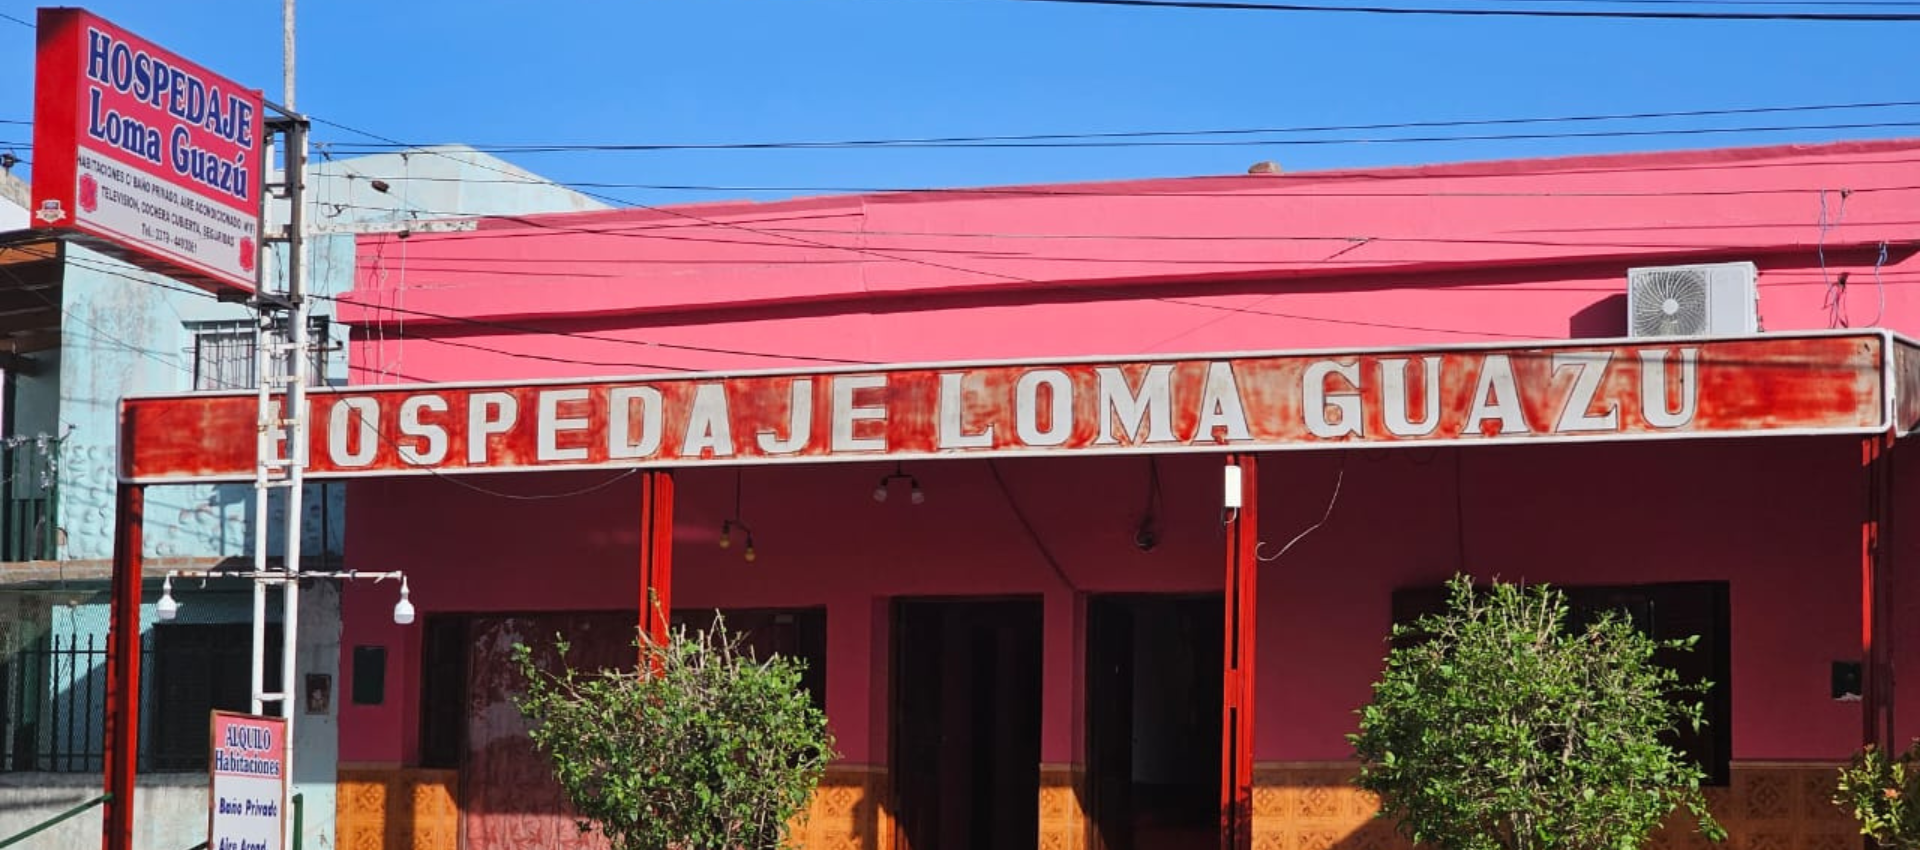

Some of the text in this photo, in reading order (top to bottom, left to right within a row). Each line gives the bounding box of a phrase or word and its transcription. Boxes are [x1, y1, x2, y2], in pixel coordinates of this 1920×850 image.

[87, 28, 253, 148] HOSPEDAJE
[89, 87, 248, 199] Loma Guazú
[141, 201, 170, 223] COCHERA
[180, 194, 195, 212] AIRE
[938, 361, 1256, 450] LOMA
[1301, 348, 1700, 439] GUAZU
[215, 725, 280, 775] ALQUILO Habitaciones
[219, 797, 277, 818] Baño Privado
